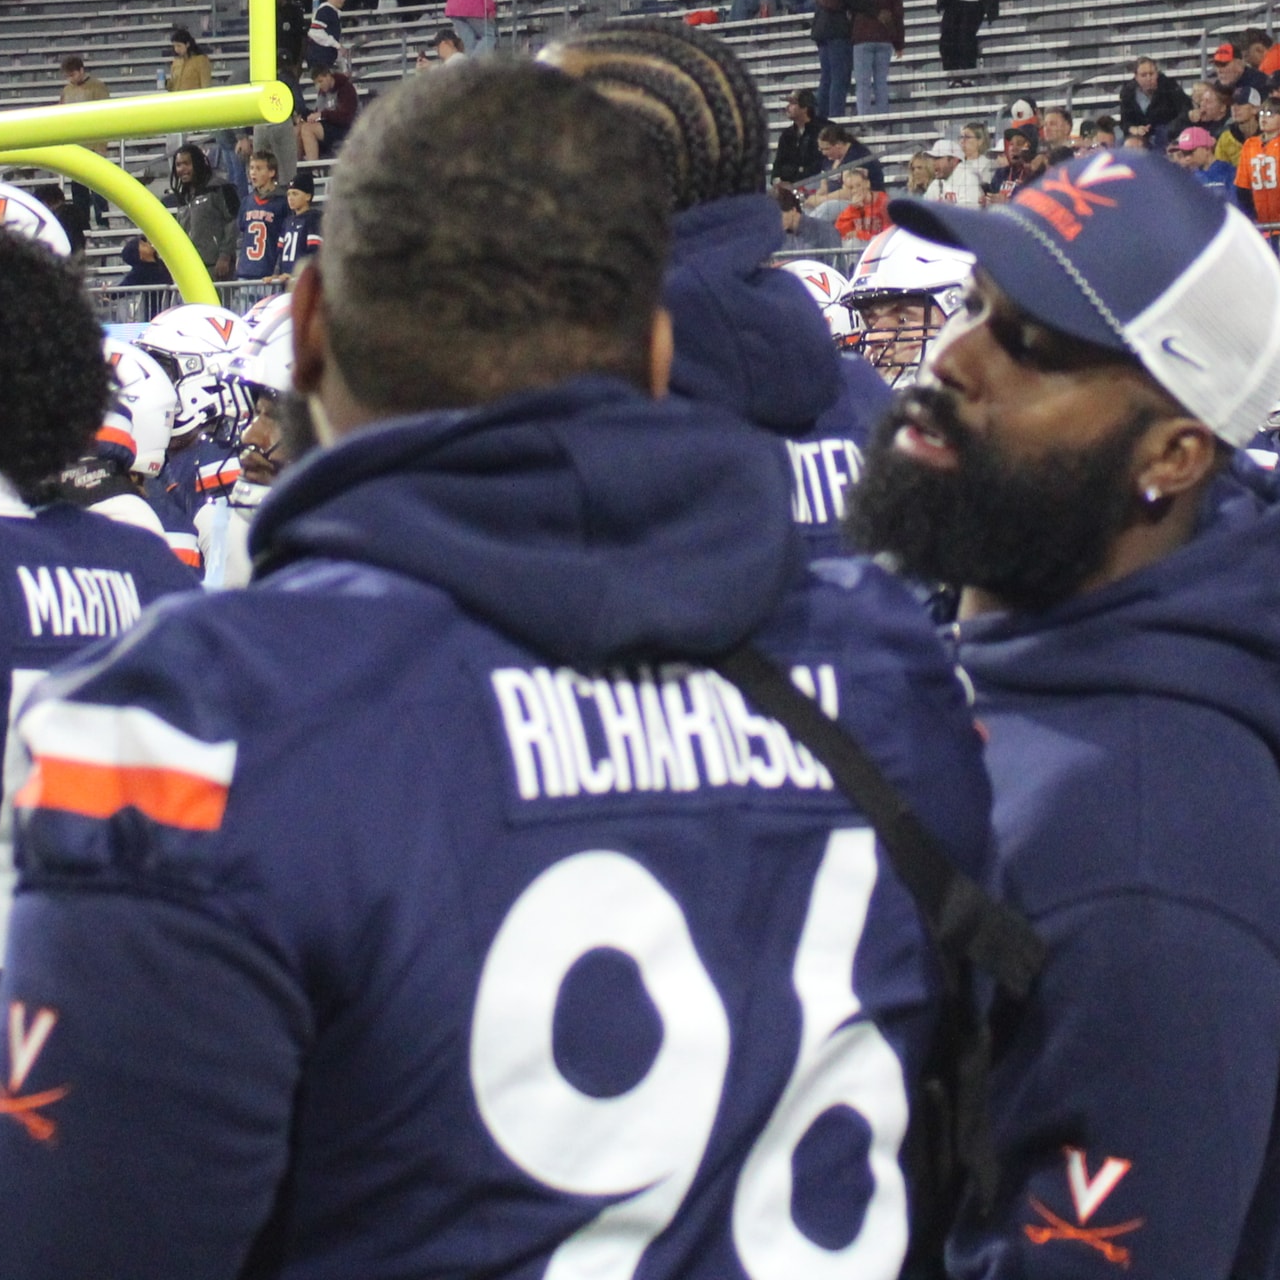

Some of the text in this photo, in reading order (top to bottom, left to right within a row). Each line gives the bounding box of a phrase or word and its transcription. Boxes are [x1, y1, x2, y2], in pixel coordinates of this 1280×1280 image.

[1250, 155, 1277, 190] 33
[246, 221, 268, 261] 3
[282, 231, 299, 262] 21
[18, 565, 140, 638] MARTIN
[470, 827, 910, 1280] 96
